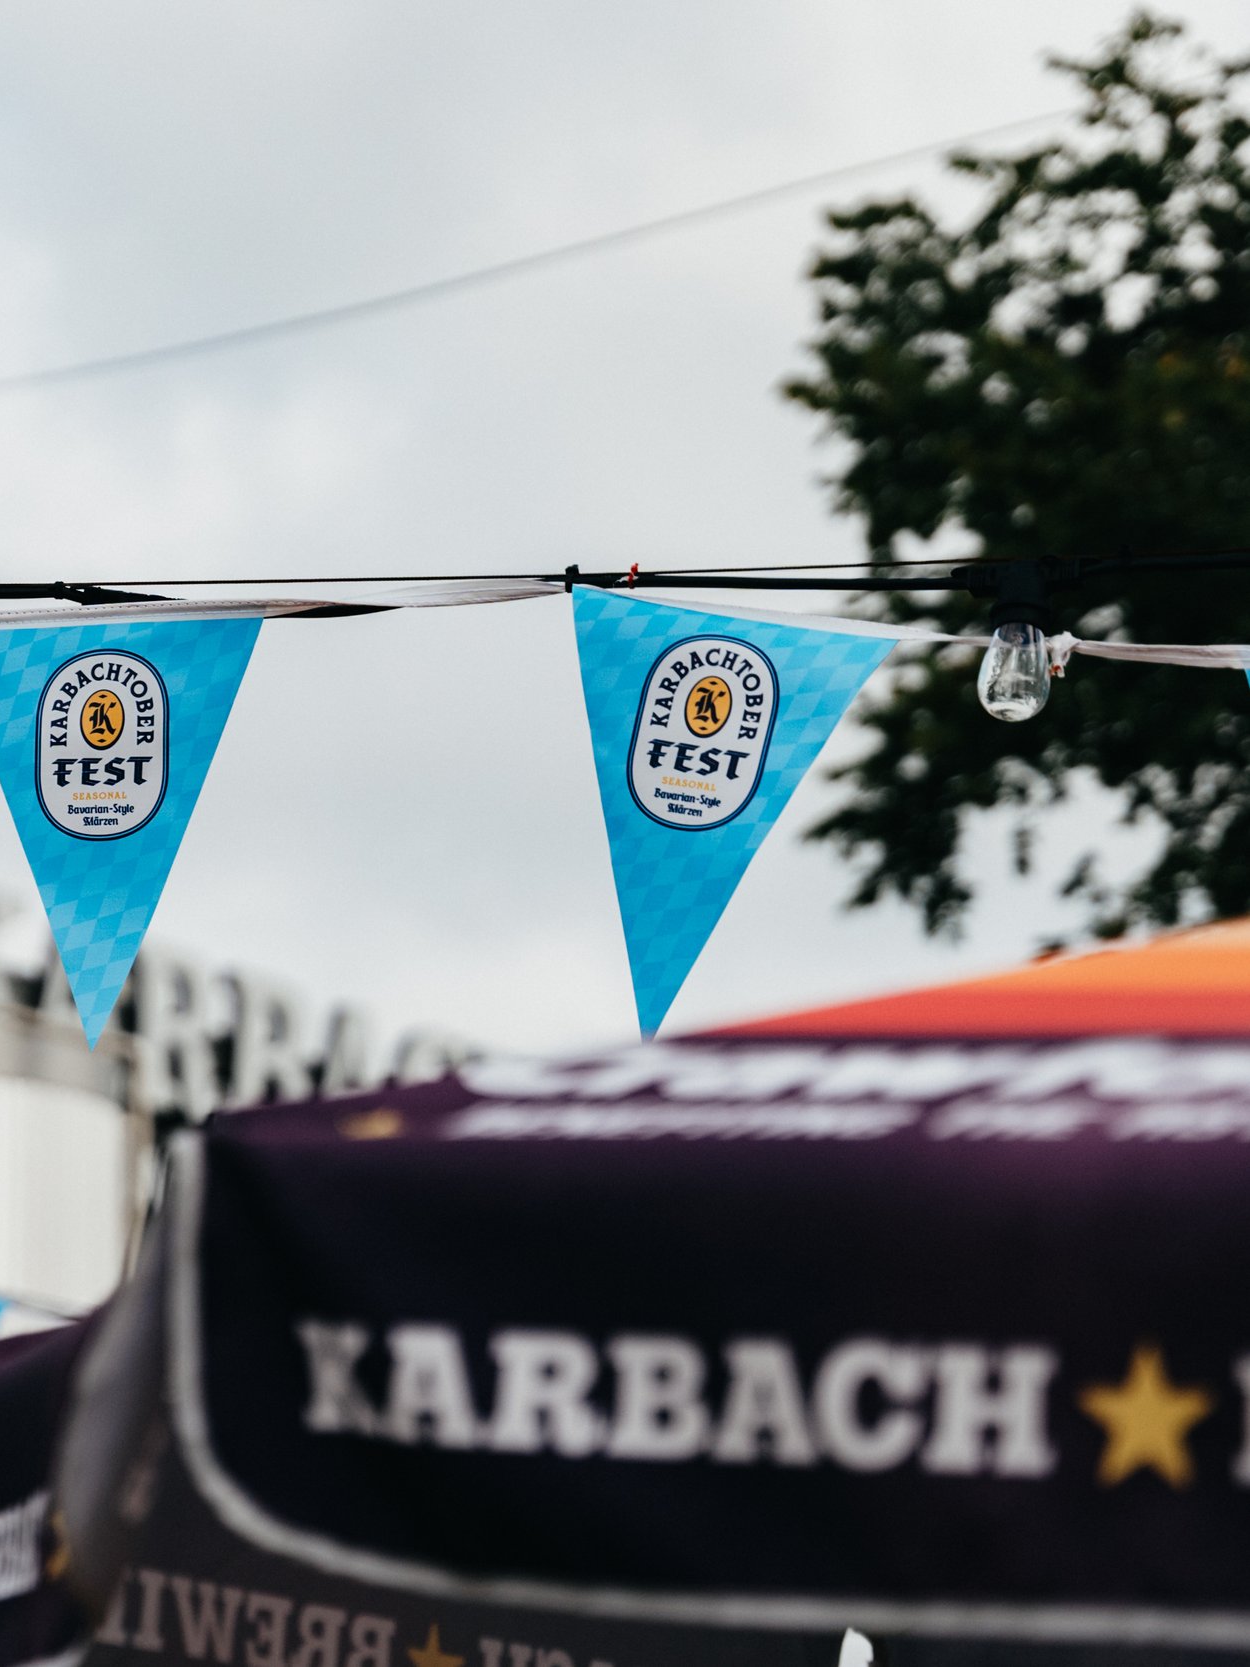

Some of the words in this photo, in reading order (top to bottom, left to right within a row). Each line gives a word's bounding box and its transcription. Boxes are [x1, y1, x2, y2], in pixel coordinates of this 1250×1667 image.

[49, 662, 155, 748] KARBACHTOBER
[650, 647, 764, 740] KARBACHTOBER
[692, 686, 727, 725] K
[88, 701, 117, 735] K
[51, 756, 154, 788] FEST
[646, 738, 751, 781] FEST
[72, 791, 128, 801] SEASONAL
[653, 787, 722, 809] Bavarian-Style
[661, 775, 717, 792] SEASONAL
[67, 803, 135, 816] Bavarian-Style
[299, 1320, 1058, 1478] KARBACH
